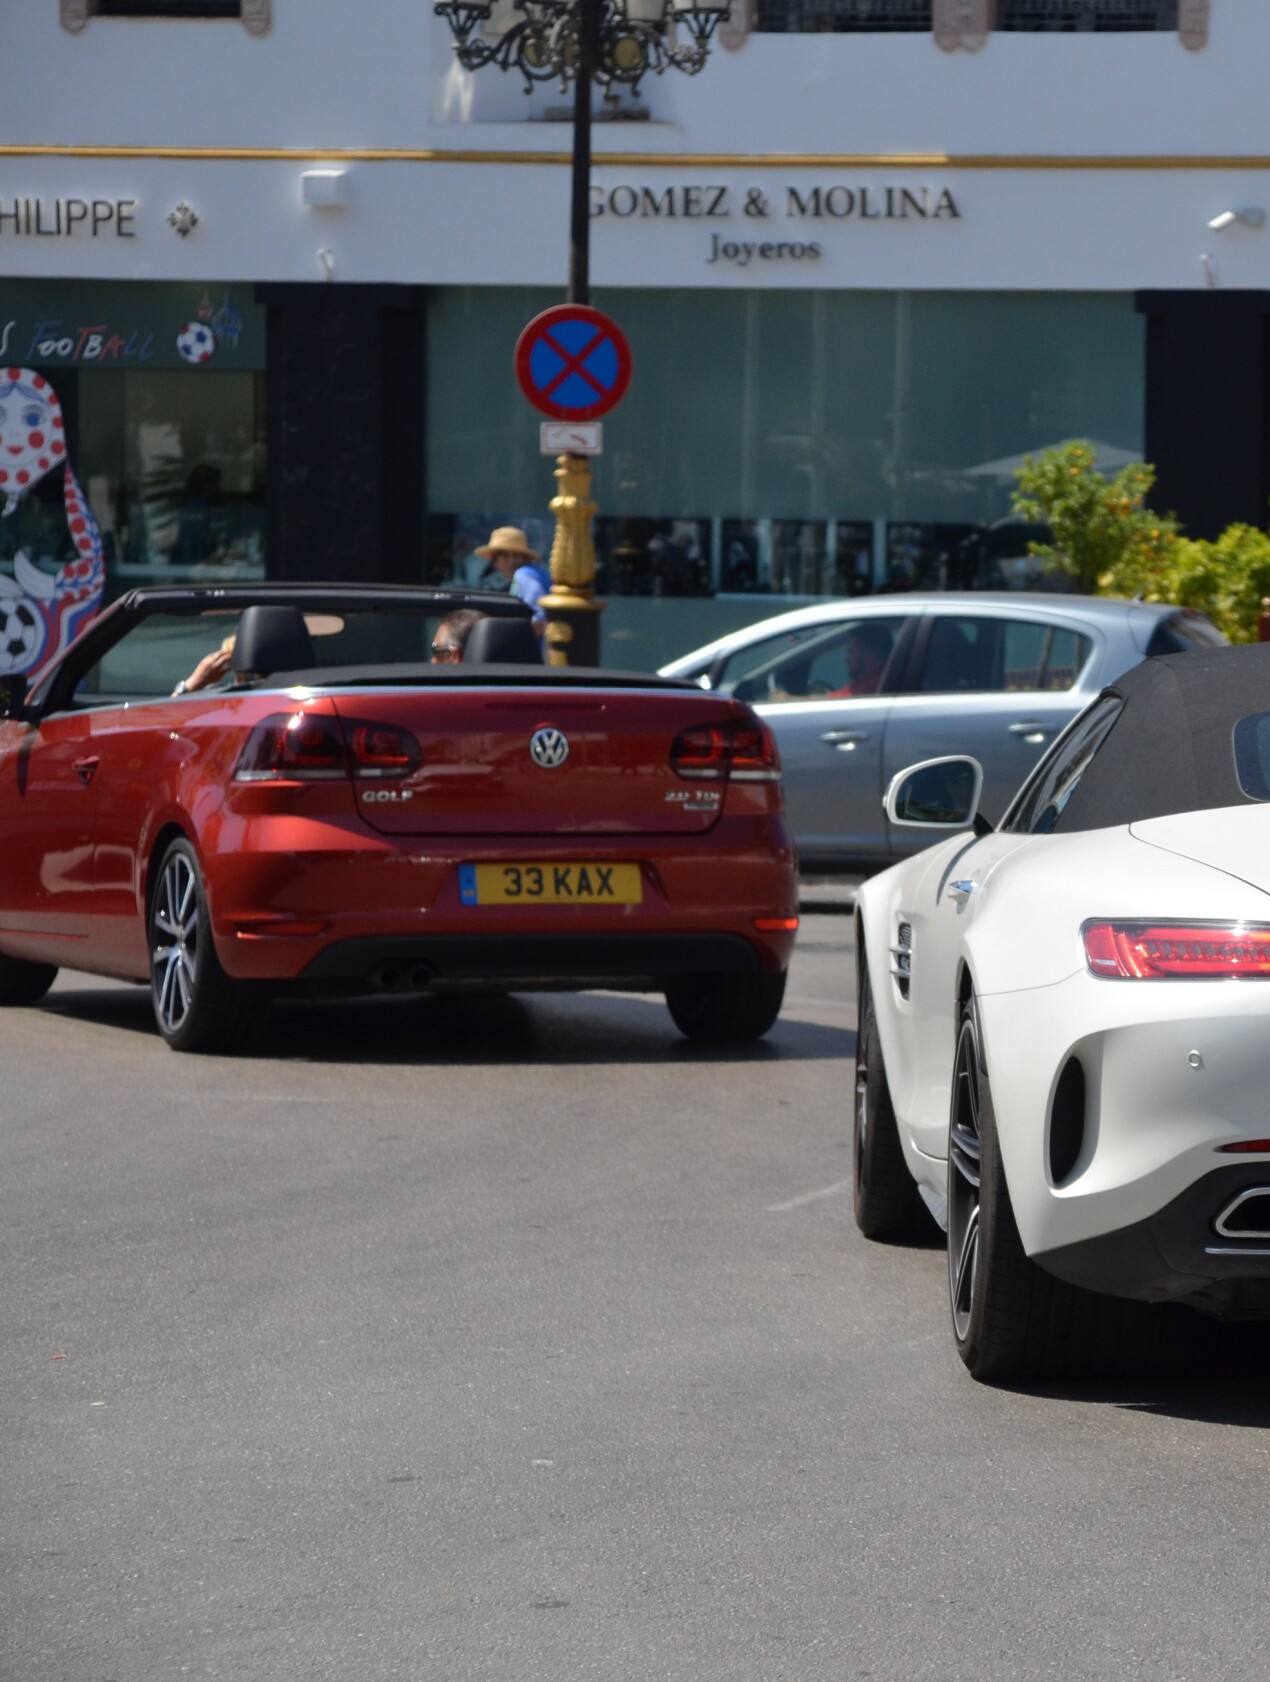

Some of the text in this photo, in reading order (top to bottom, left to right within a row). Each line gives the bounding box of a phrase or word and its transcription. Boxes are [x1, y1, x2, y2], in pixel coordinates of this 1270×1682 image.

[743, 186, 768, 218] &
[784, 185, 961, 219] MOLINA
[706, 232, 822, 266] Joyeros
[362, 790, 413, 803] GOLF
[503, 867, 614, 896] 33 KAX
